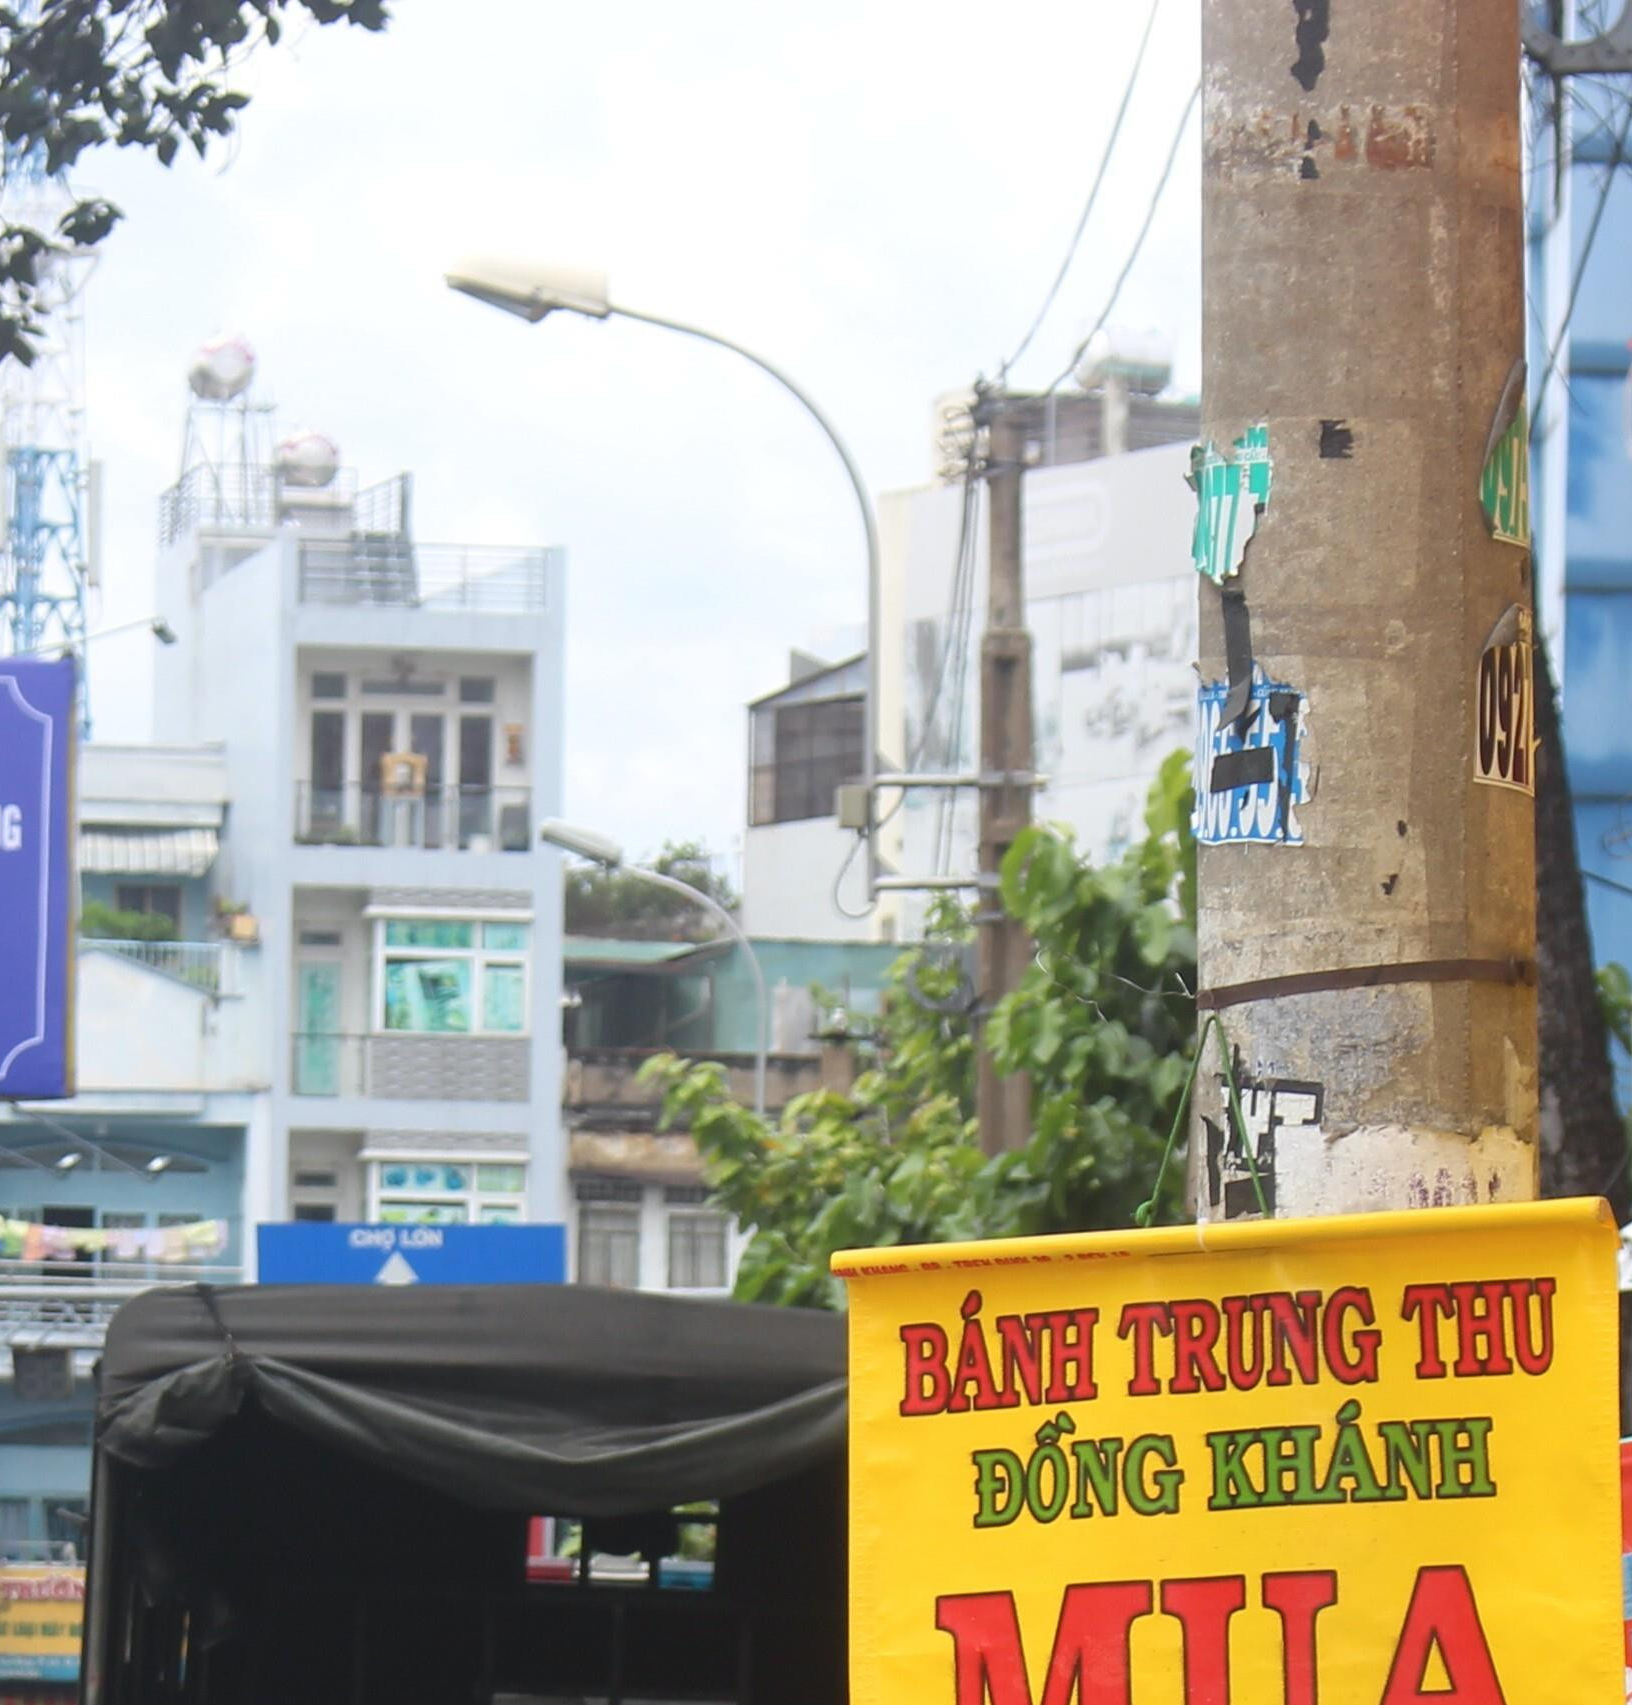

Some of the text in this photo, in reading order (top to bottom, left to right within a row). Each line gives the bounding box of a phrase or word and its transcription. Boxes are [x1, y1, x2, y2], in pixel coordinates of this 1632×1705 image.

[899, 1277, 1556, 1417] BÁNH TRUNG THU
[973, 1399, 1497, 1529] ĐỒNG KHÁNH
